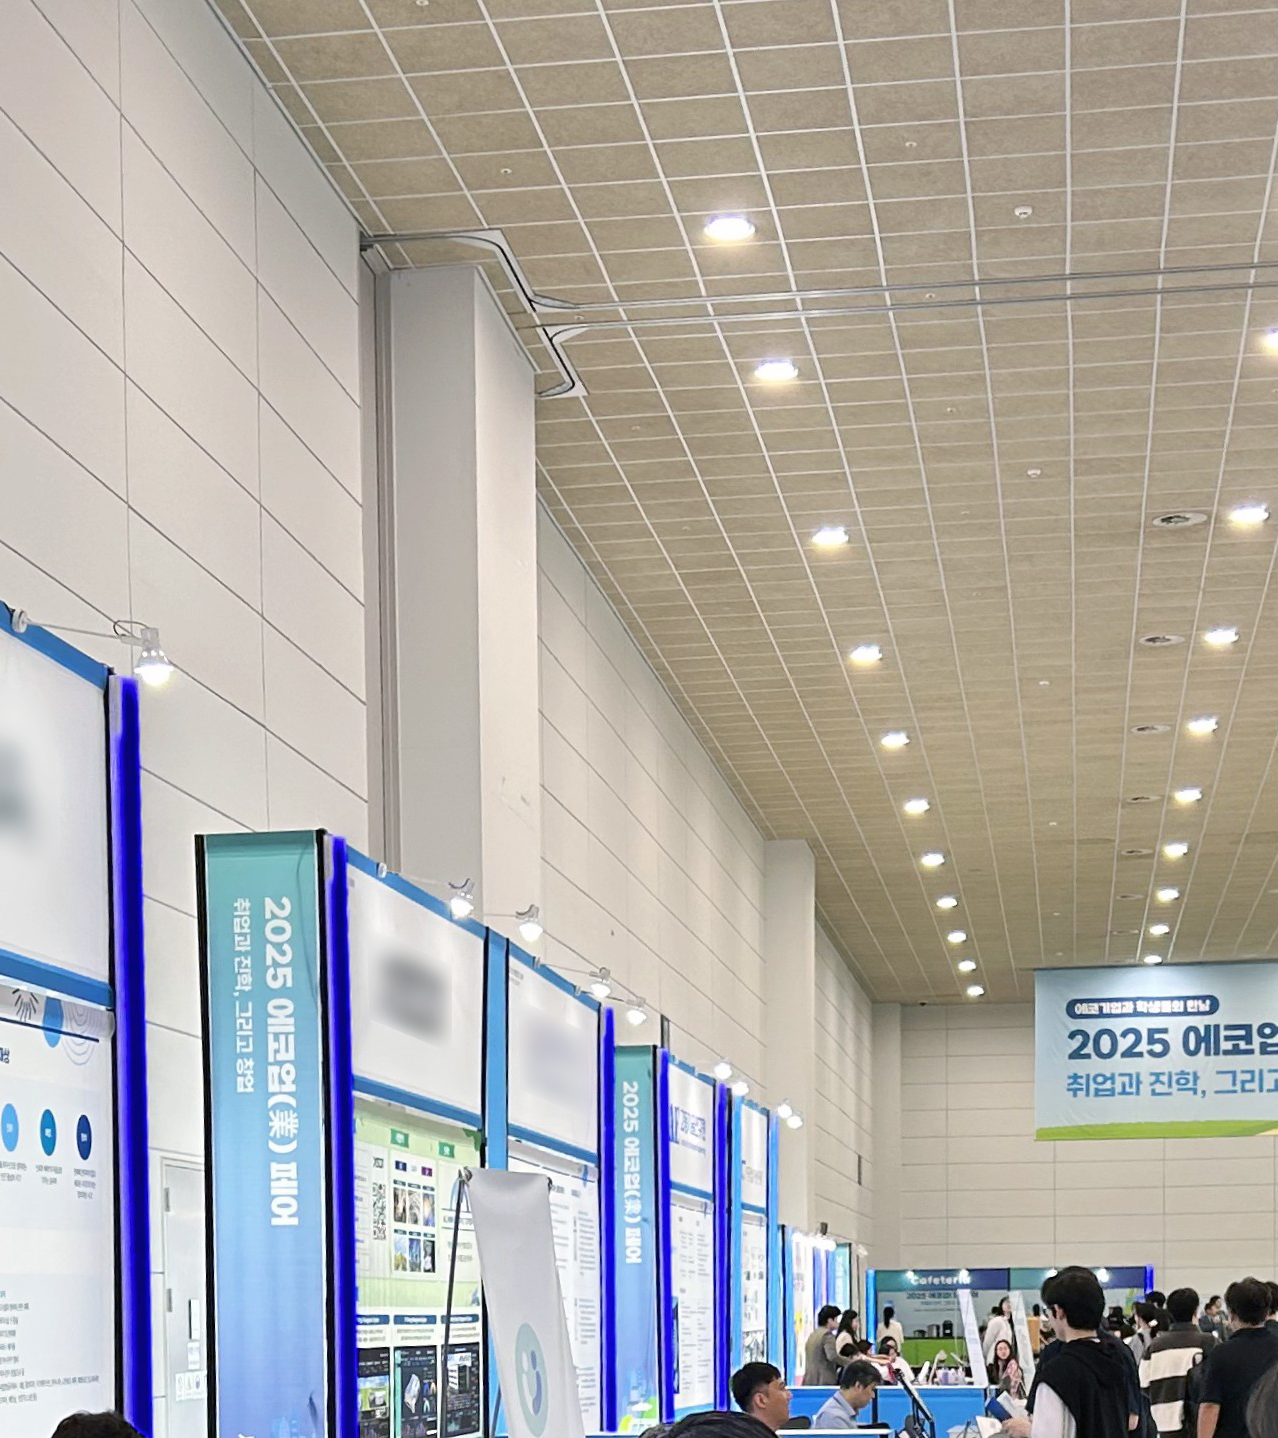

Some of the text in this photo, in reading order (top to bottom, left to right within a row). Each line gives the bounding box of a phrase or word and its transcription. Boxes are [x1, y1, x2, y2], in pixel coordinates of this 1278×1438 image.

[233, 898, 255, 1093] 취업과 진학, 그리고 창업
[1186, 999, 1210, 1013] 만남
[264, 897, 299, 1226] 2025 에코업(業) 페어
[1067, 1027, 1170, 1060] 2025
[1067, 1071, 1142, 1098] 취업과
[1149, 1070, 1207, 1098] 진학,
[623, 1080, 639, 1133] 2025
[625, 1227, 642, 1264] 페어
